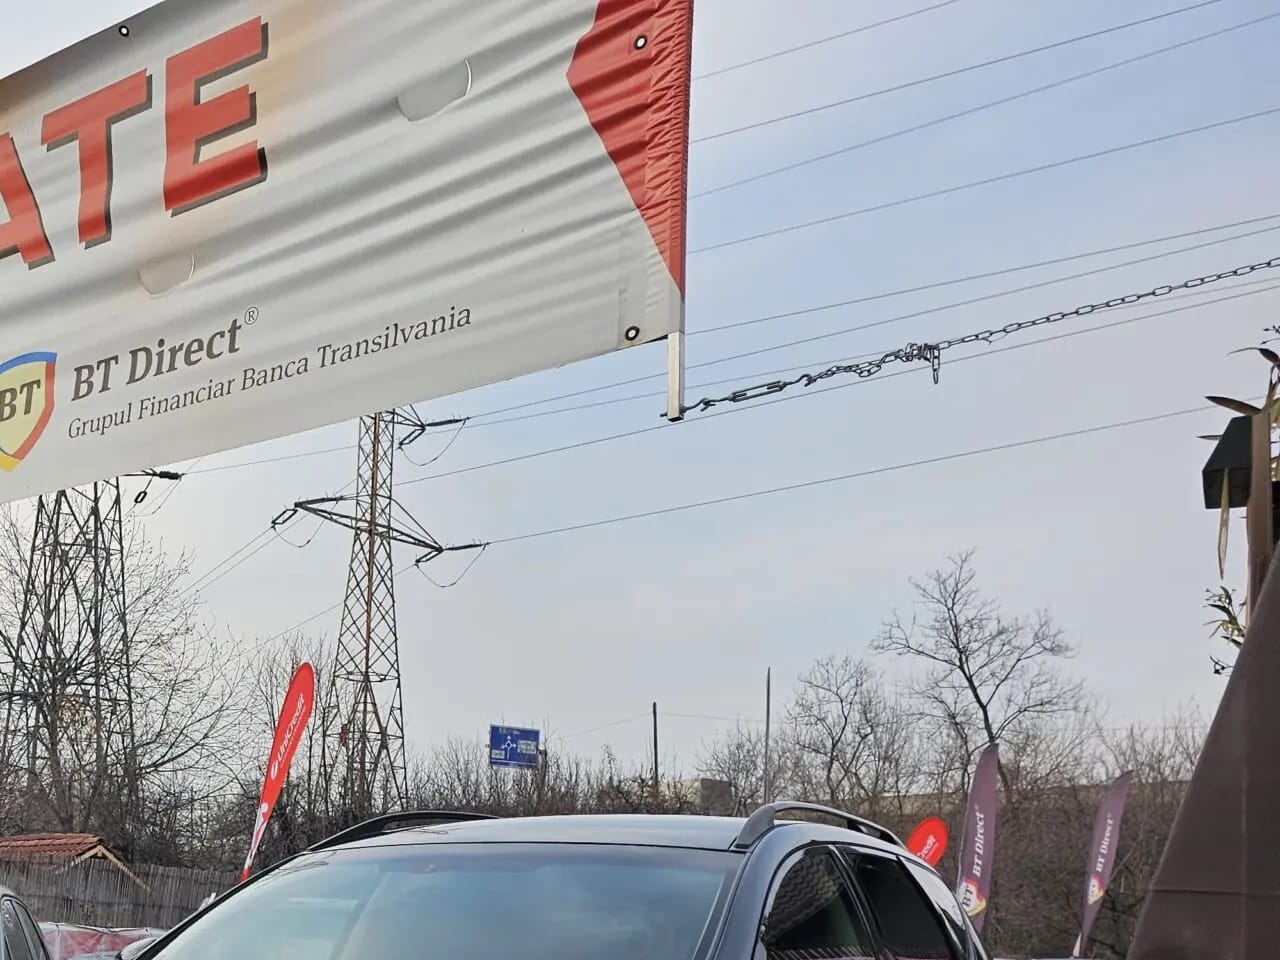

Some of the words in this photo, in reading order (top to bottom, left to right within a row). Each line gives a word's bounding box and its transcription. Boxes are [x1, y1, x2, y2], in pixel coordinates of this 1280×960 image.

[68, 402, 132, 438] Grupul
[138, 377, 235, 420] Financiar
[241, 356, 309, 391] Banca
[318, 305, 472, 368] Transilvania
[71, 355, 119, 402] BT
[278, 692, 305, 762] UniCredit
[972, 854, 983, 877] BT
